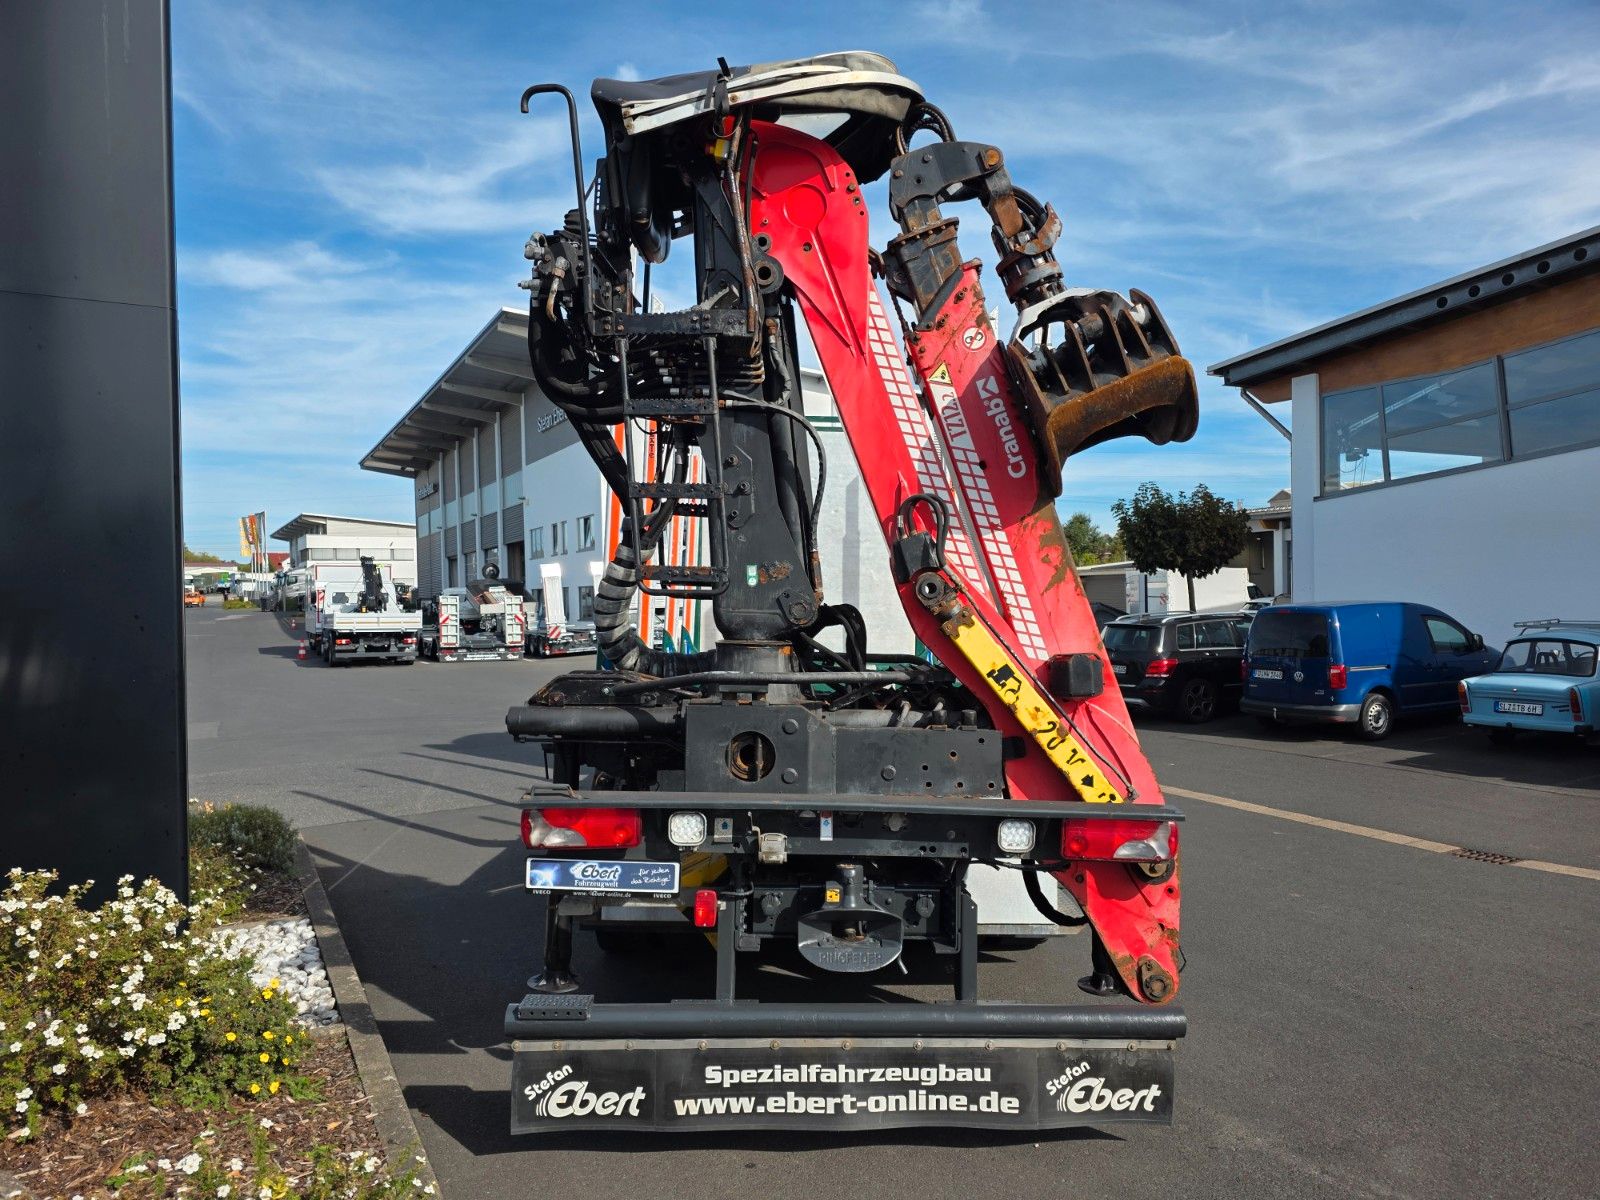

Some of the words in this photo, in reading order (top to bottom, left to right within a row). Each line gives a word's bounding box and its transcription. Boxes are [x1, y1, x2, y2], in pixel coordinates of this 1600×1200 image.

[986, 397, 1027, 479] Cranab
[581, 864, 619, 879] Ebert
[523, 1064, 574, 1101] Stefan
[704, 1063, 992, 1088] Spezialfahrzeugbau
[1045, 1061, 1091, 1097] Stefan
[547, 1081, 647, 1118] Ebert
[673, 1089, 1021, 1116] www.ebert-online.de
[1066, 1077, 1162, 1113] Ebert
